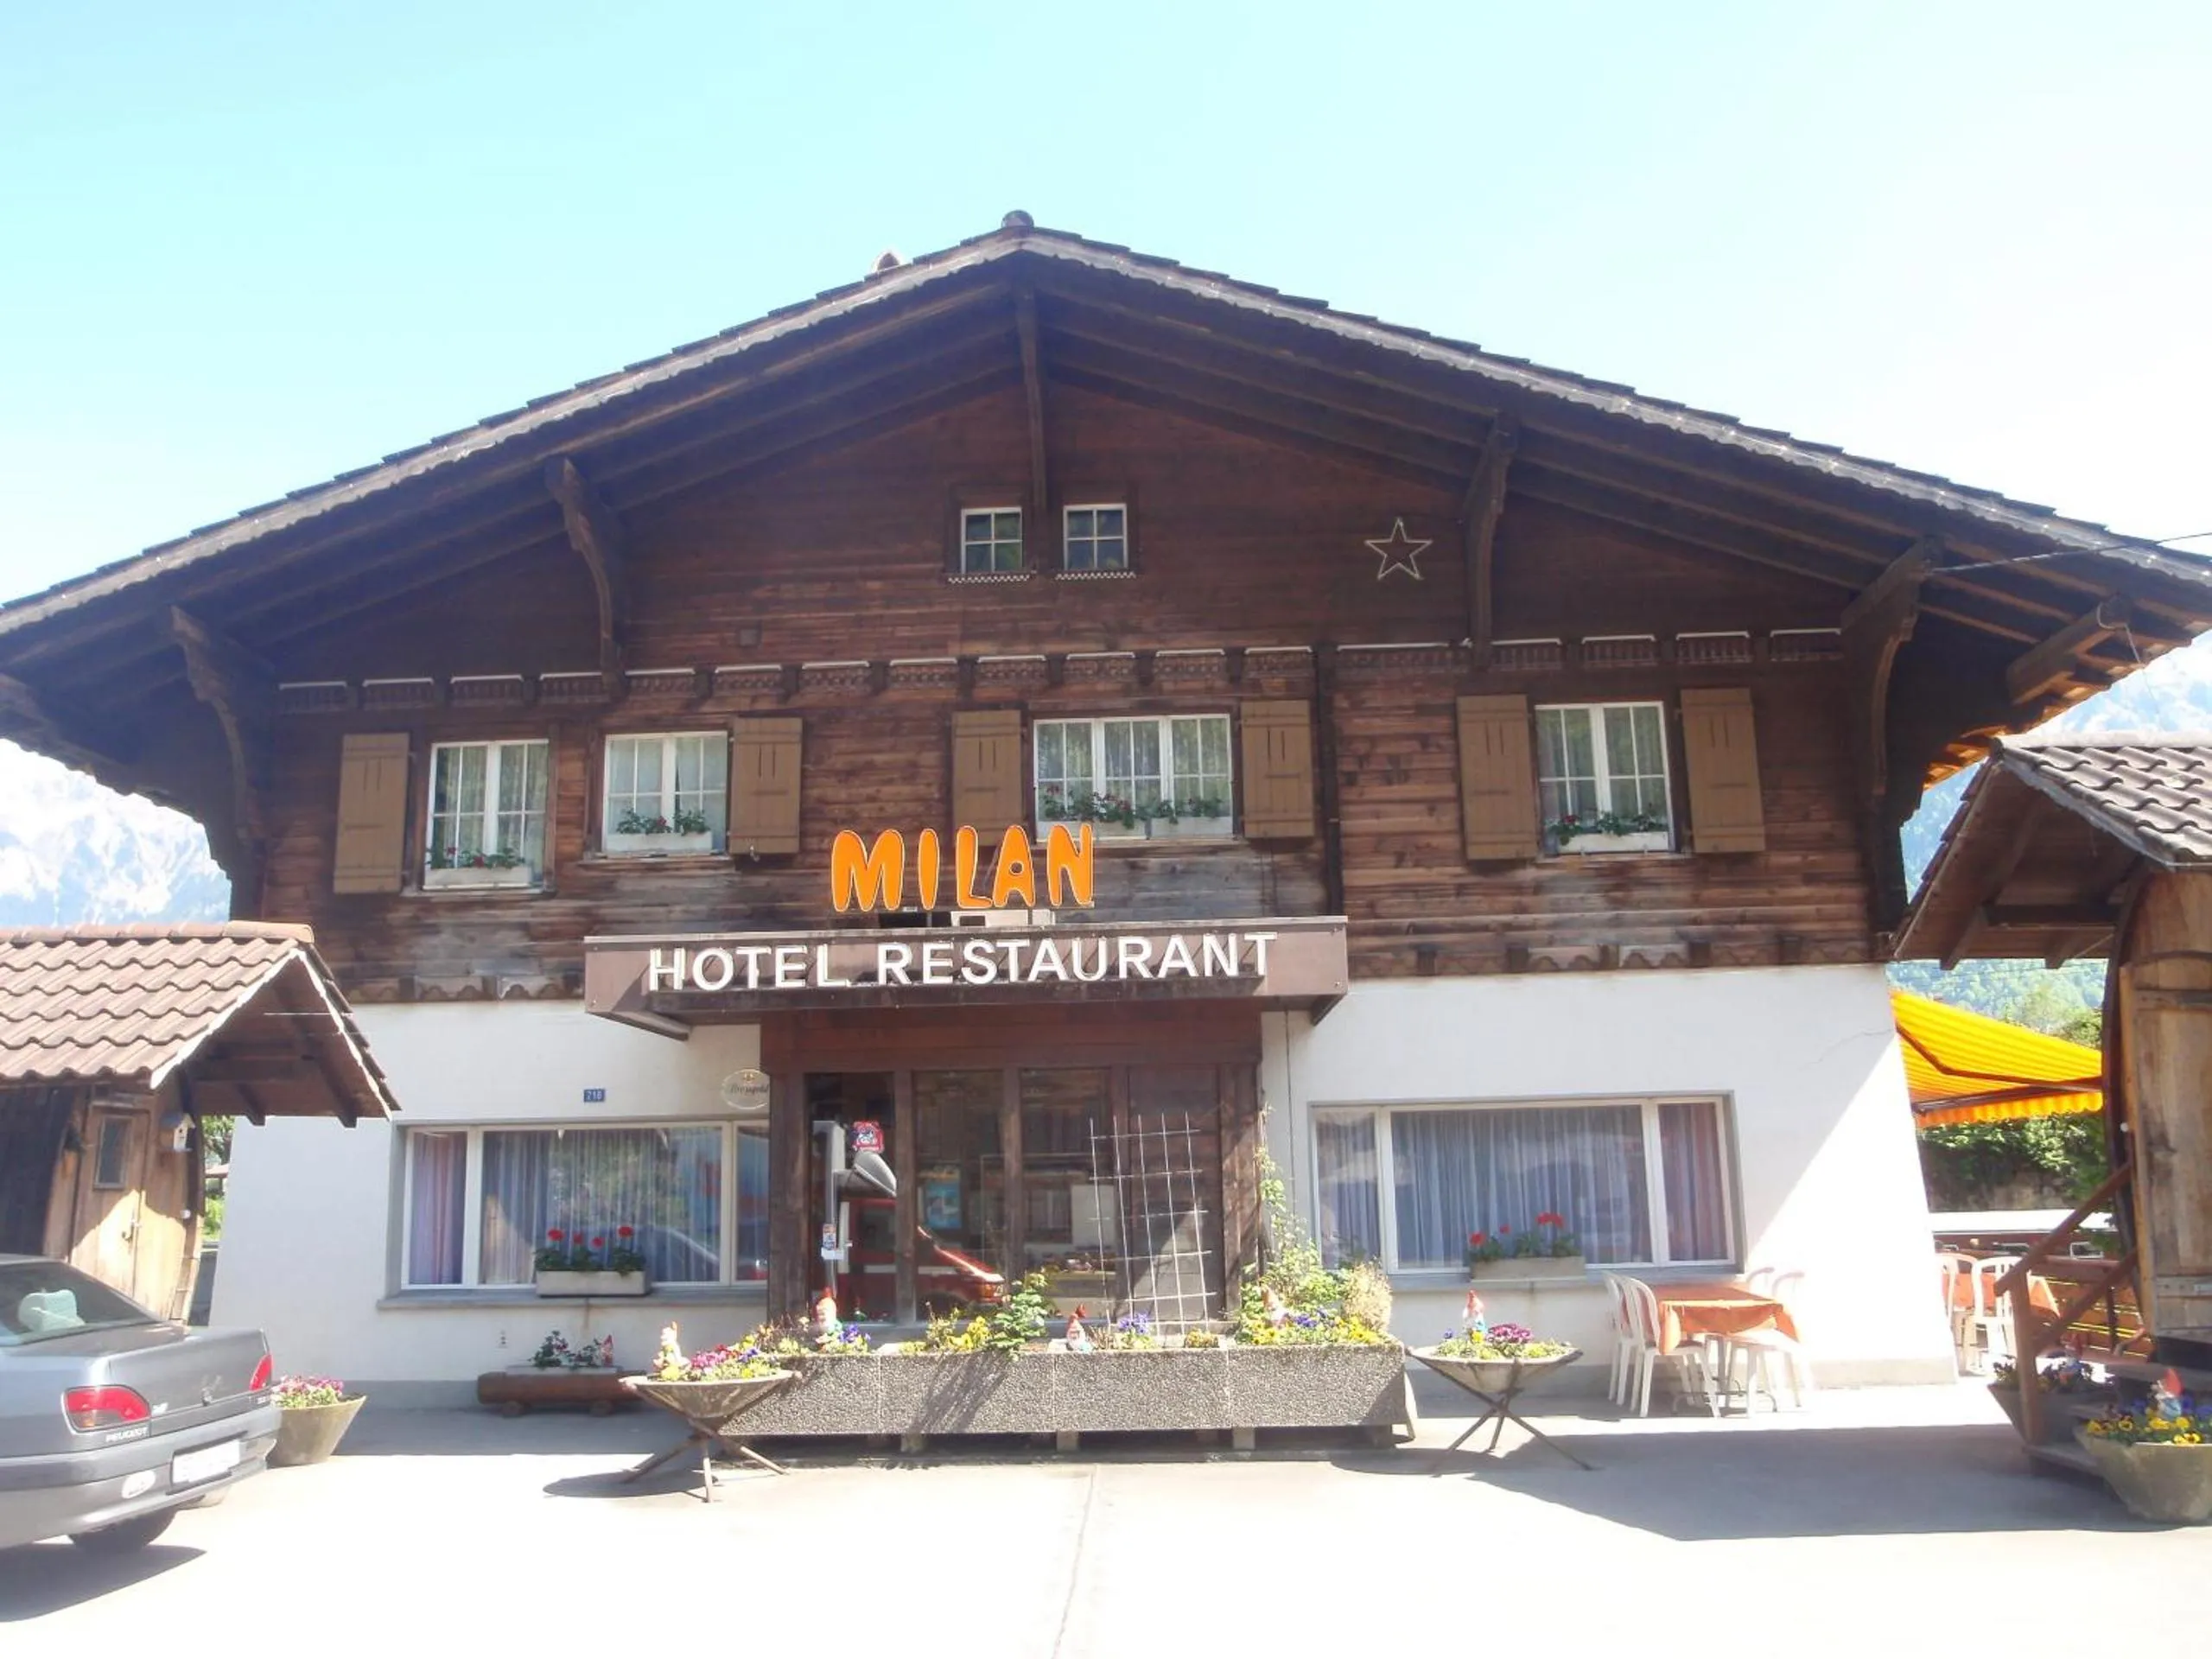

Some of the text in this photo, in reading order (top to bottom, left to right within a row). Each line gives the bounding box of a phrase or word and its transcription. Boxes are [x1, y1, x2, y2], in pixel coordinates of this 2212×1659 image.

[831, 824, 1094, 912] MILAN
[648, 931, 1278, 991] HOTEL RESTAURANT
